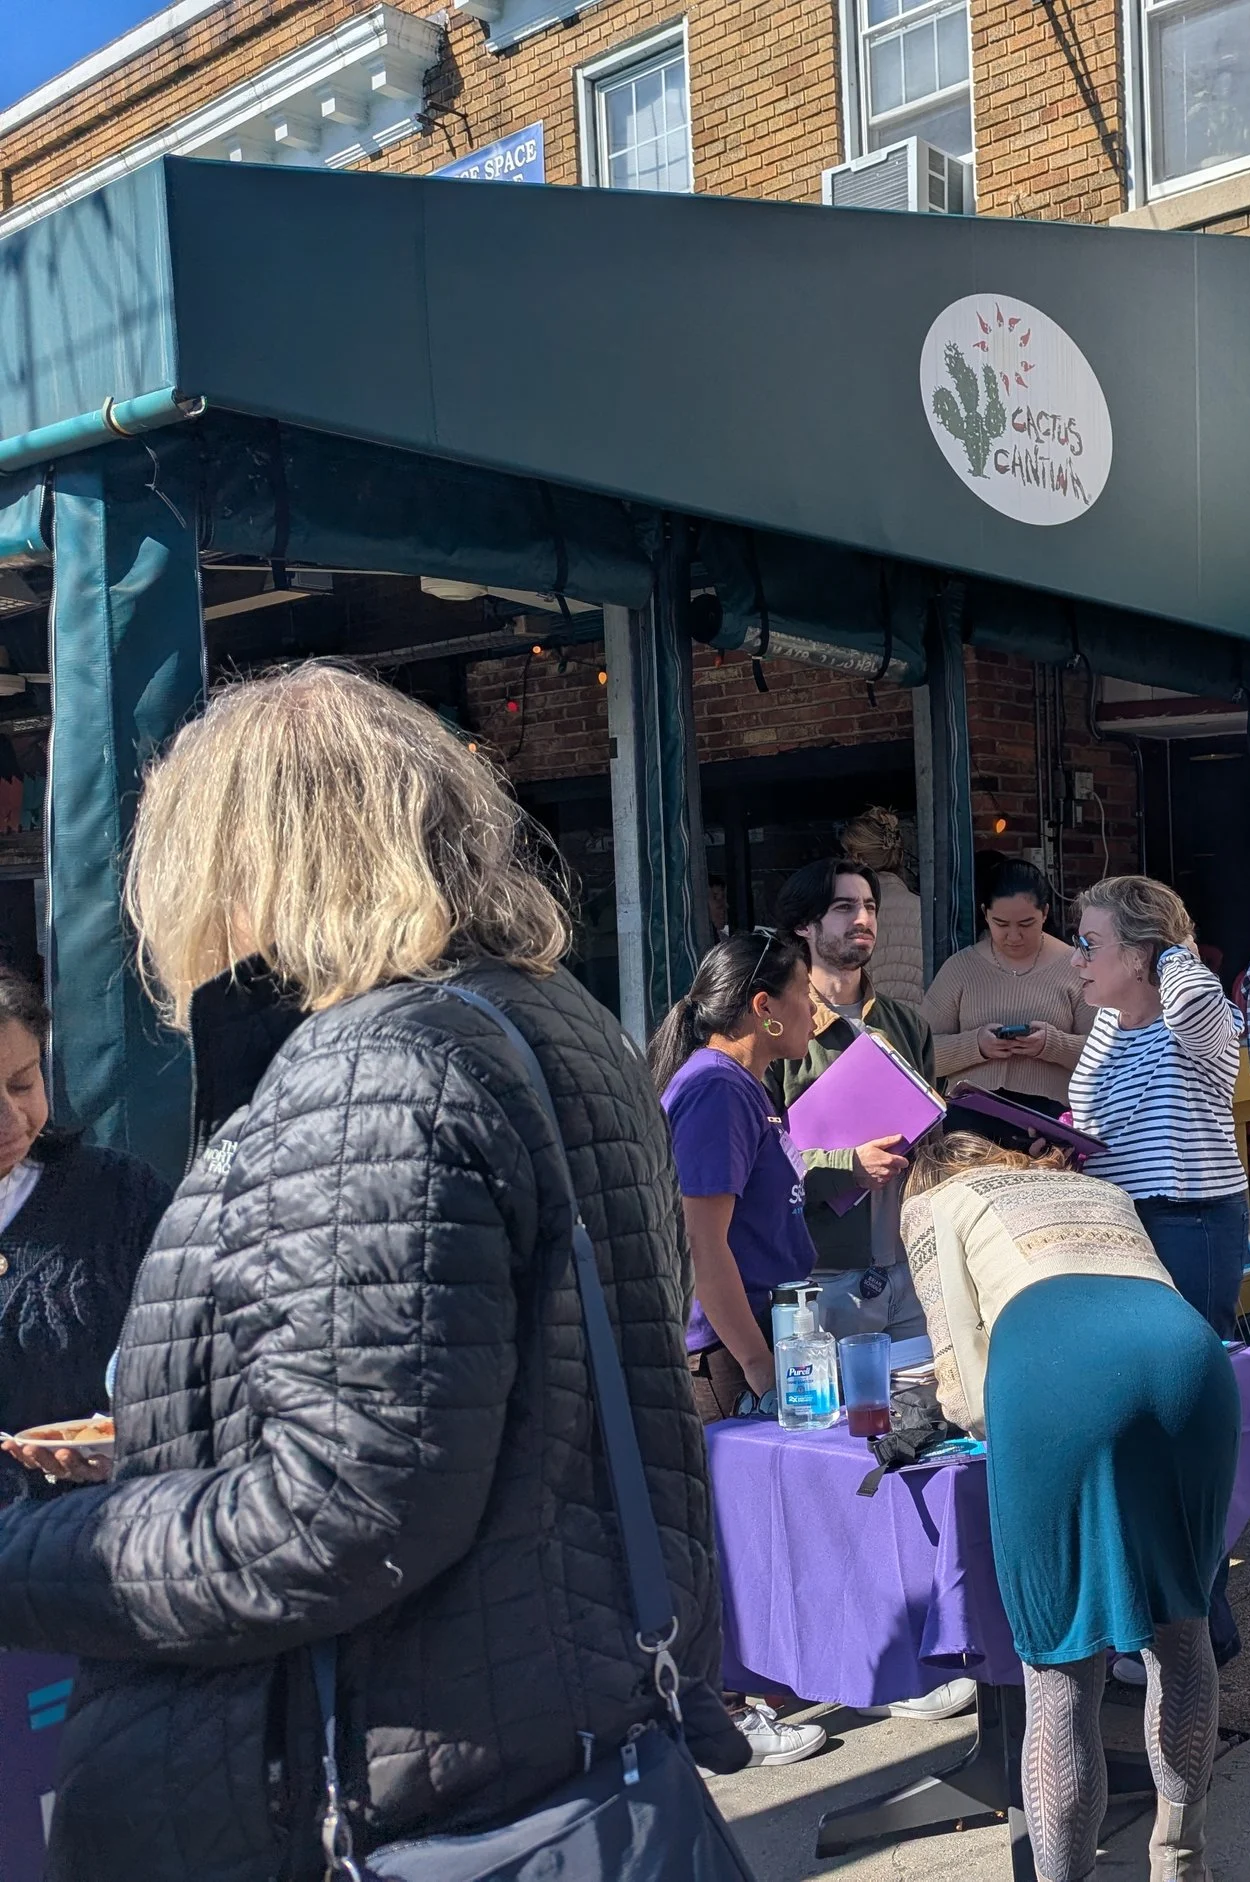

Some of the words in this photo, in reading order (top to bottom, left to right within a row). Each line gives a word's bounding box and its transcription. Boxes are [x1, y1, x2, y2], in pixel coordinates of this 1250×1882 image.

[484, 140, 537, 180] SPACE
[1011, 406, 1083, 456] CACTUS
[994, 445, 1089, 505] CANTINA
[789, 1367, 811, 1377] Purell
